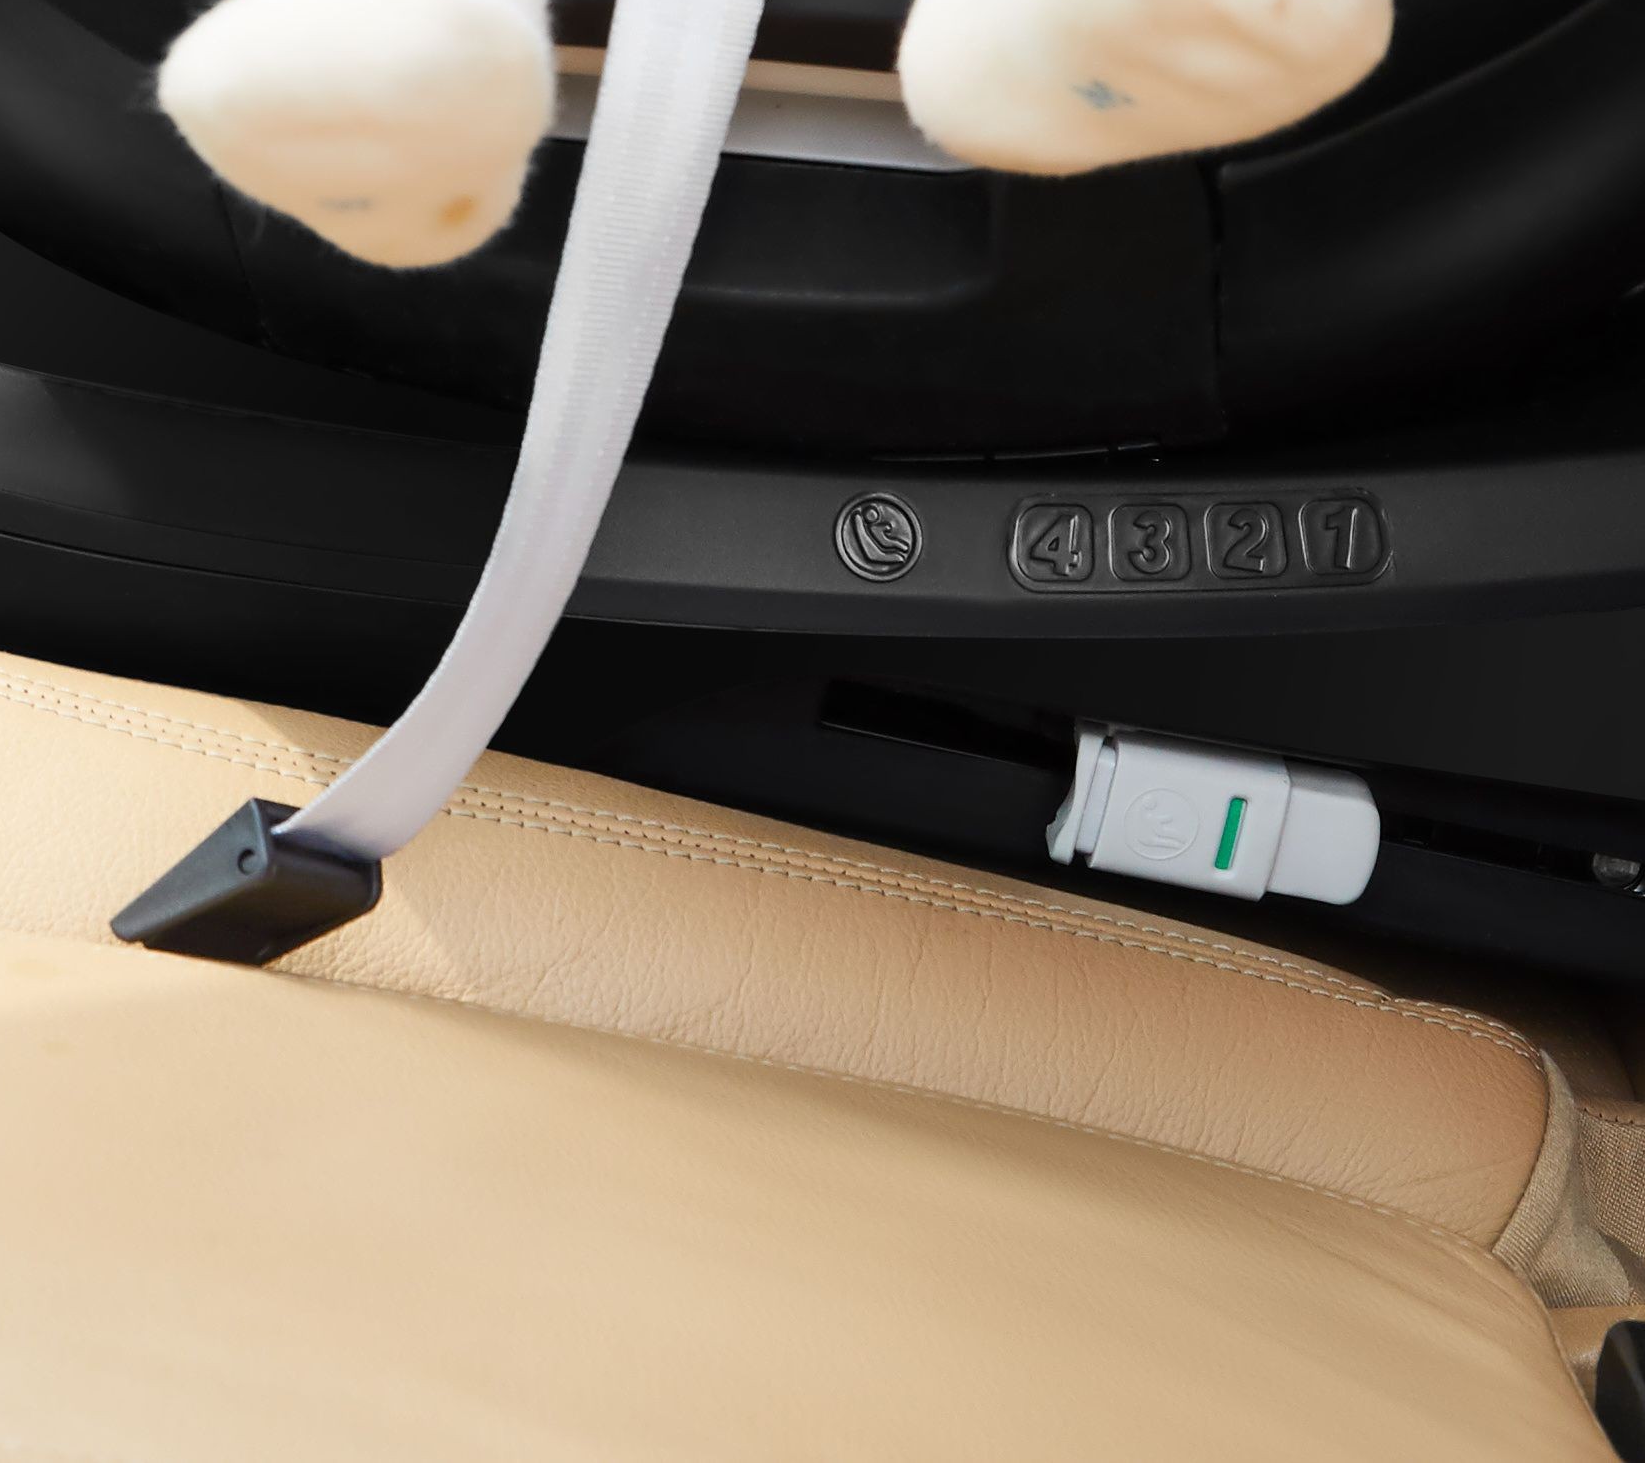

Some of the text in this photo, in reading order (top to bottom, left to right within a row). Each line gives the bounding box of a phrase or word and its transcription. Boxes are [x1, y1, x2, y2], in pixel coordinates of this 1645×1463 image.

[1030, 506, 1360, 577] 4 3 2 1
